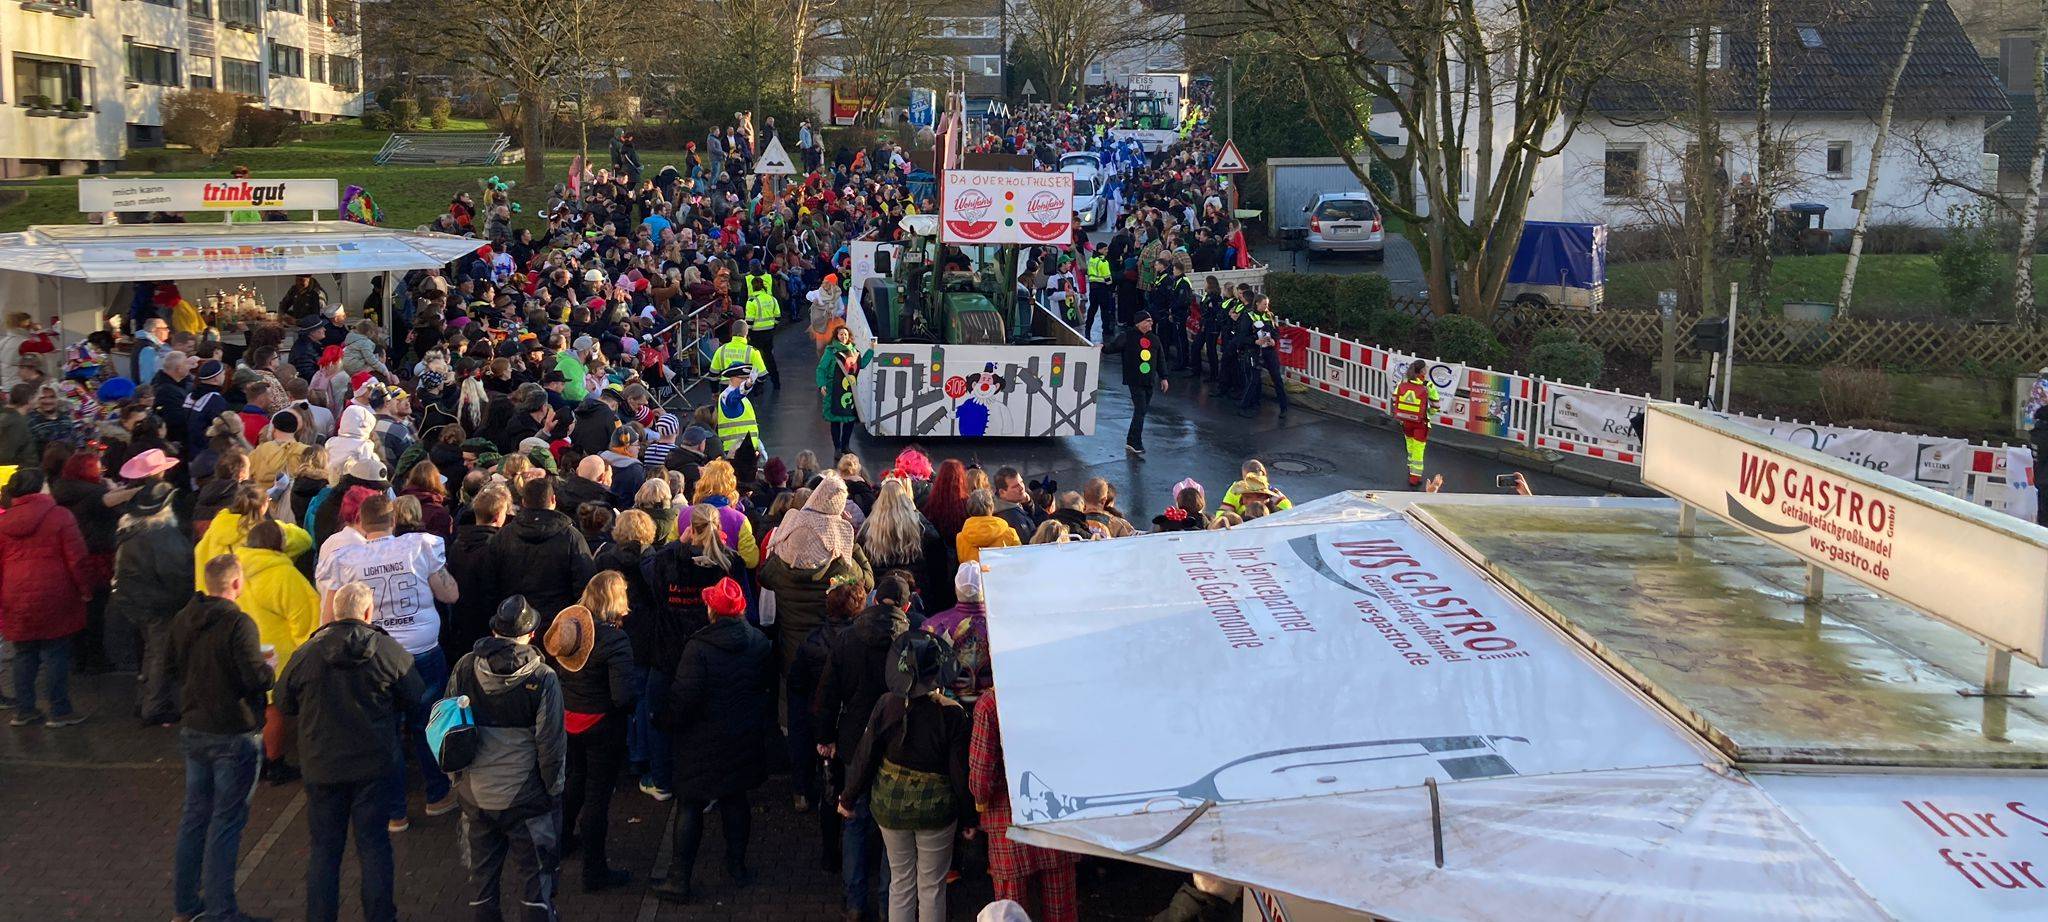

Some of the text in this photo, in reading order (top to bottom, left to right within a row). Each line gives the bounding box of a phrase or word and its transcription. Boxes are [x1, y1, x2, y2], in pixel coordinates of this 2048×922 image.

[112, 188, 137, 196] mich
[204, 182, 286, 205] trinkgut
[950, 174, 966, 185] DA
[138, 196, 172, 205] mieten
[946, 379, 966, 395] STOP
[1924, 461, 1950, 470] VELTINS
[1739, 452, 1896, 538] WS GASTRO GmbH
[1781, 500, 1892, 559] Getränkefachgroßhandel
[363, 561, 405, 577] LIGHTNINGS
[1810, 535, 1890, 581] ws-gastro.de
[1176, 551, 1276, 648] für die Gastronomie
[1225, 547, 1317, 632] Ihr Servicepartner
[1332, 538, 1530, 661] WS GASTRO GmbH
[384, 616, 415, 627] GEIGER
[1353, 599, 1430, 666] ws-gastro.de
[1360, 574, 1472, 663] Getränkefachgroßhandel
[1901, 800, 2009, 838] Ihr
[1938, 848, 2047, 889] für
